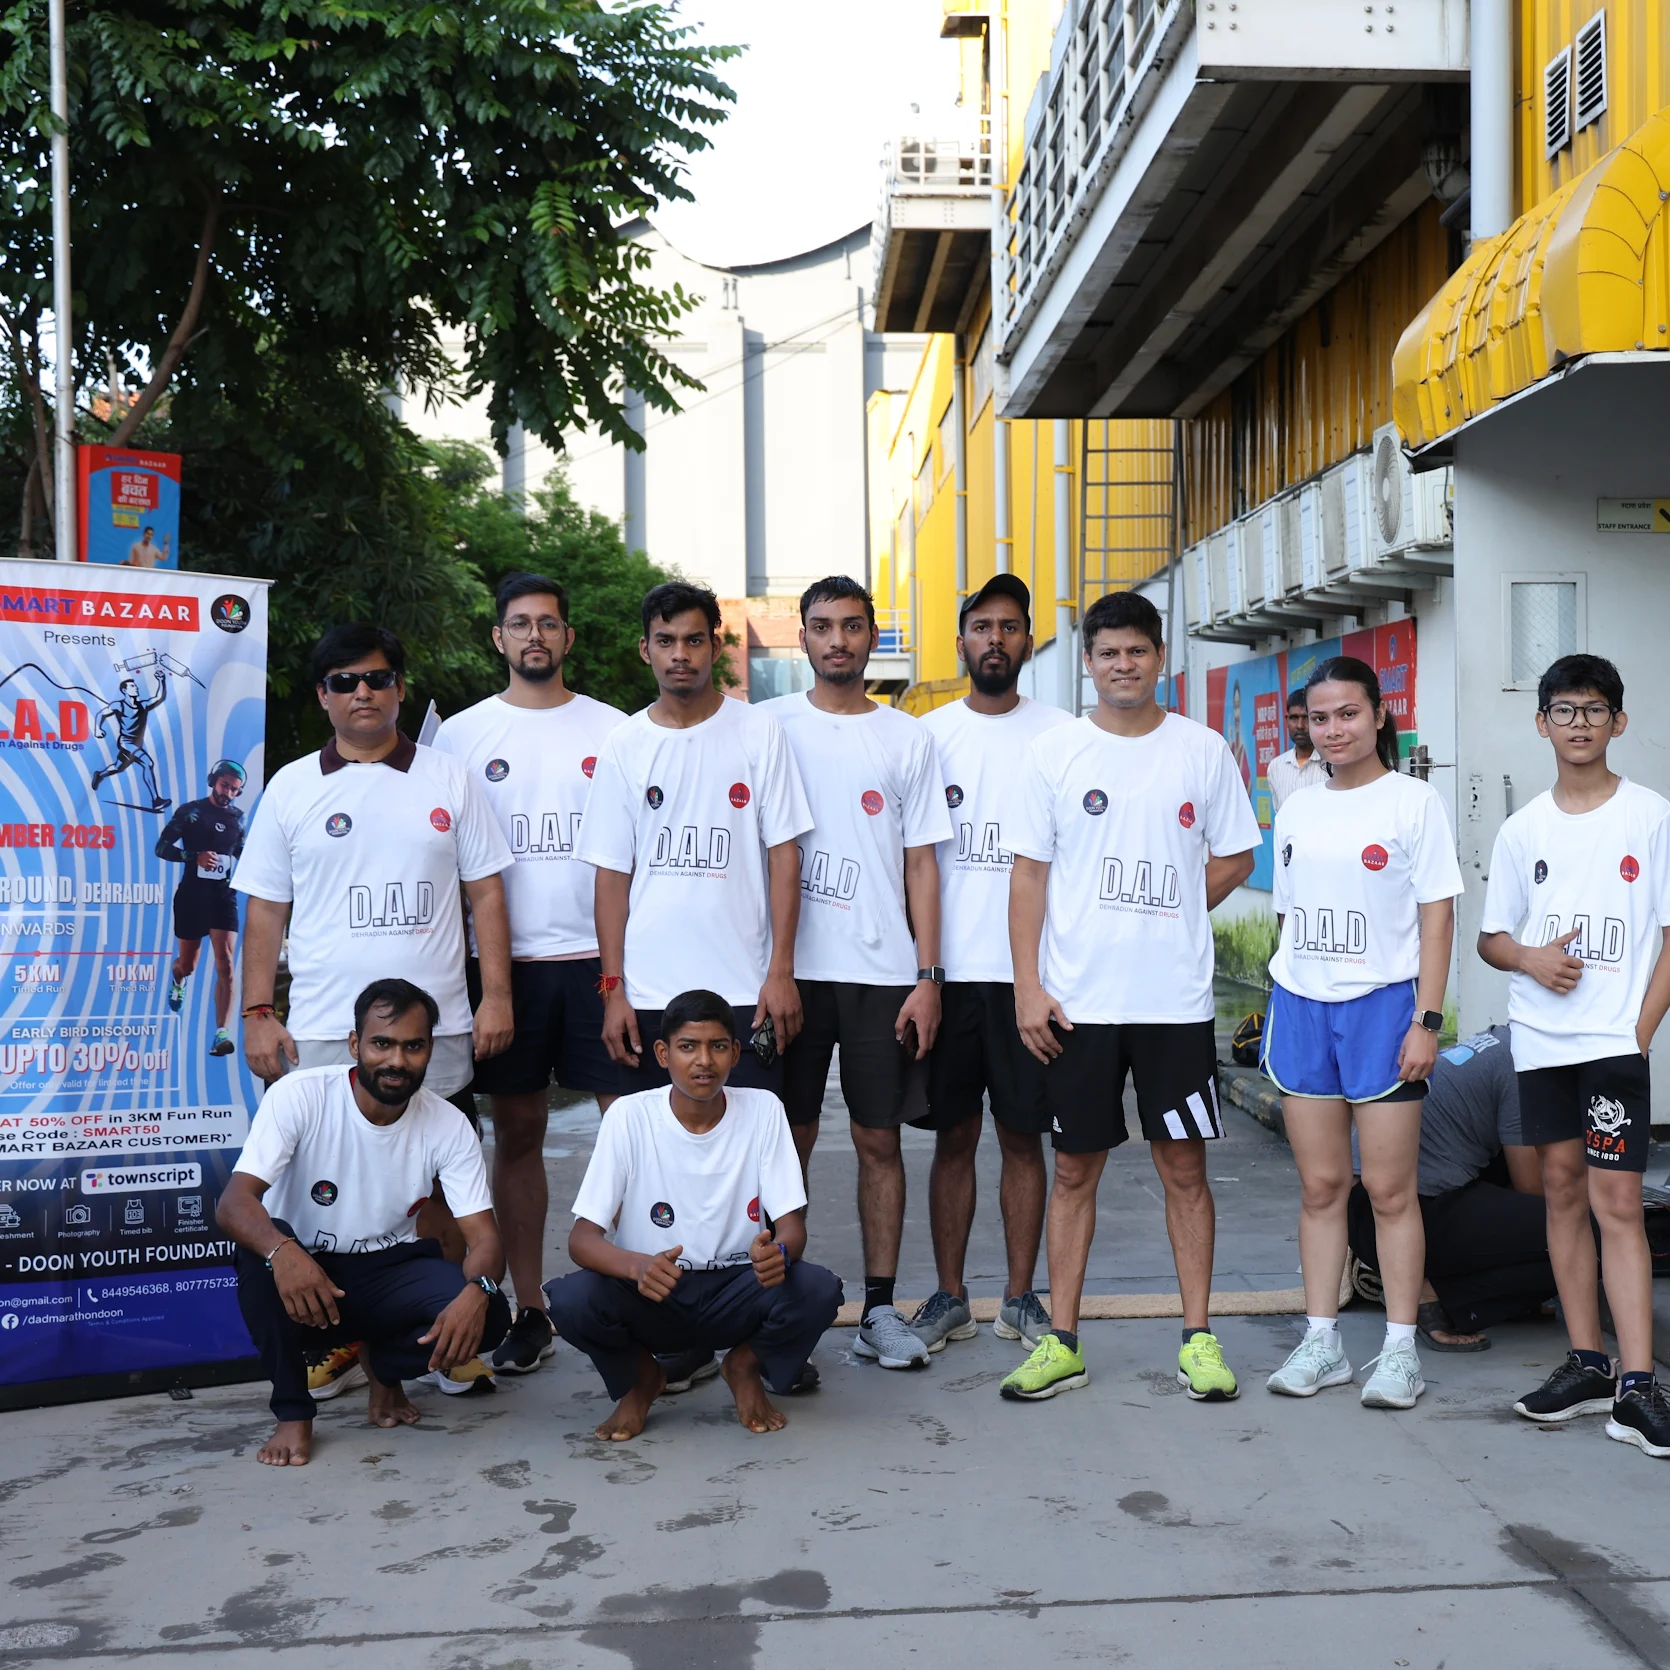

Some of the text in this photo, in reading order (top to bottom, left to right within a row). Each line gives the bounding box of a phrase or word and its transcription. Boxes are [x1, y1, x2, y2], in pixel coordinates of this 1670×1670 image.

[0, 594, 191, 622] MART BAZAAR
[44, 631, 116, 647] Presents
[9, 740, 50, 750] Against
[53, 741, 84, 752] Drugs
[61, 824, 115, 849] 2025
[956, 821, 1015, 865] D.A.
[649, 826, 731, 870] D.A.D
[1099, 857, 1182, 909] D.A.D
[82, 882, 165, 905] DEHRADUN
[349, 881, 434, 929] D.A.D
[831, 901, 851, 911] DRUGS
[1099, 903, 1179, 919] DEHRADUN AGAINST DRUGS
[351, 927, 434, 938] DEHRADUN AGAINST DRUGS
[1293, 906, 1367, 955] D.A.D
[1344, 957, 1366, 965] DRUGS
[1598, 964, 1621, 973] DRUGS
[15, 964, 156, 983] 5KM 10KM
[12, 985, 65, 993] Timed Run
[110, 984, 156, 992] Timed Run
[12, 1025, 158, 1039] EARLY BIRD DISCOUNT
[0, 1041, 169, 1075] UPTO 30% off
[10, 1080, 35, 1089] Offer
[62, 1079, 82, 1088] valid
[0, 1109, 232, 1128] AT 50% OFF in 3KM Fun Run
[23, 1130, 68, 1140] Code
[83, 1125, 160, 1138] SMART50
[52, 1139, 123, 1151] BAZAAR
[1601, 1152, 1620, 1161] 1890
[16, 1179, 57, 1191] NOW
[60, 1177, 76, 1189] AT
[108, 1168, 195, 1186] townscript
[0, 1218, 204, 1240] eshment Photography Timed bib Finisher
[174, 1225, 209, 1234] certificate
[19, 1254, 74, 1272] DOON
[80, 1248, 140, 1268] YOUTH
[0, 1277, 239, 1309] on@gmail.com 8449546368, 807775732
[22, 1307, 124, 1326] /dadmarathondoon
